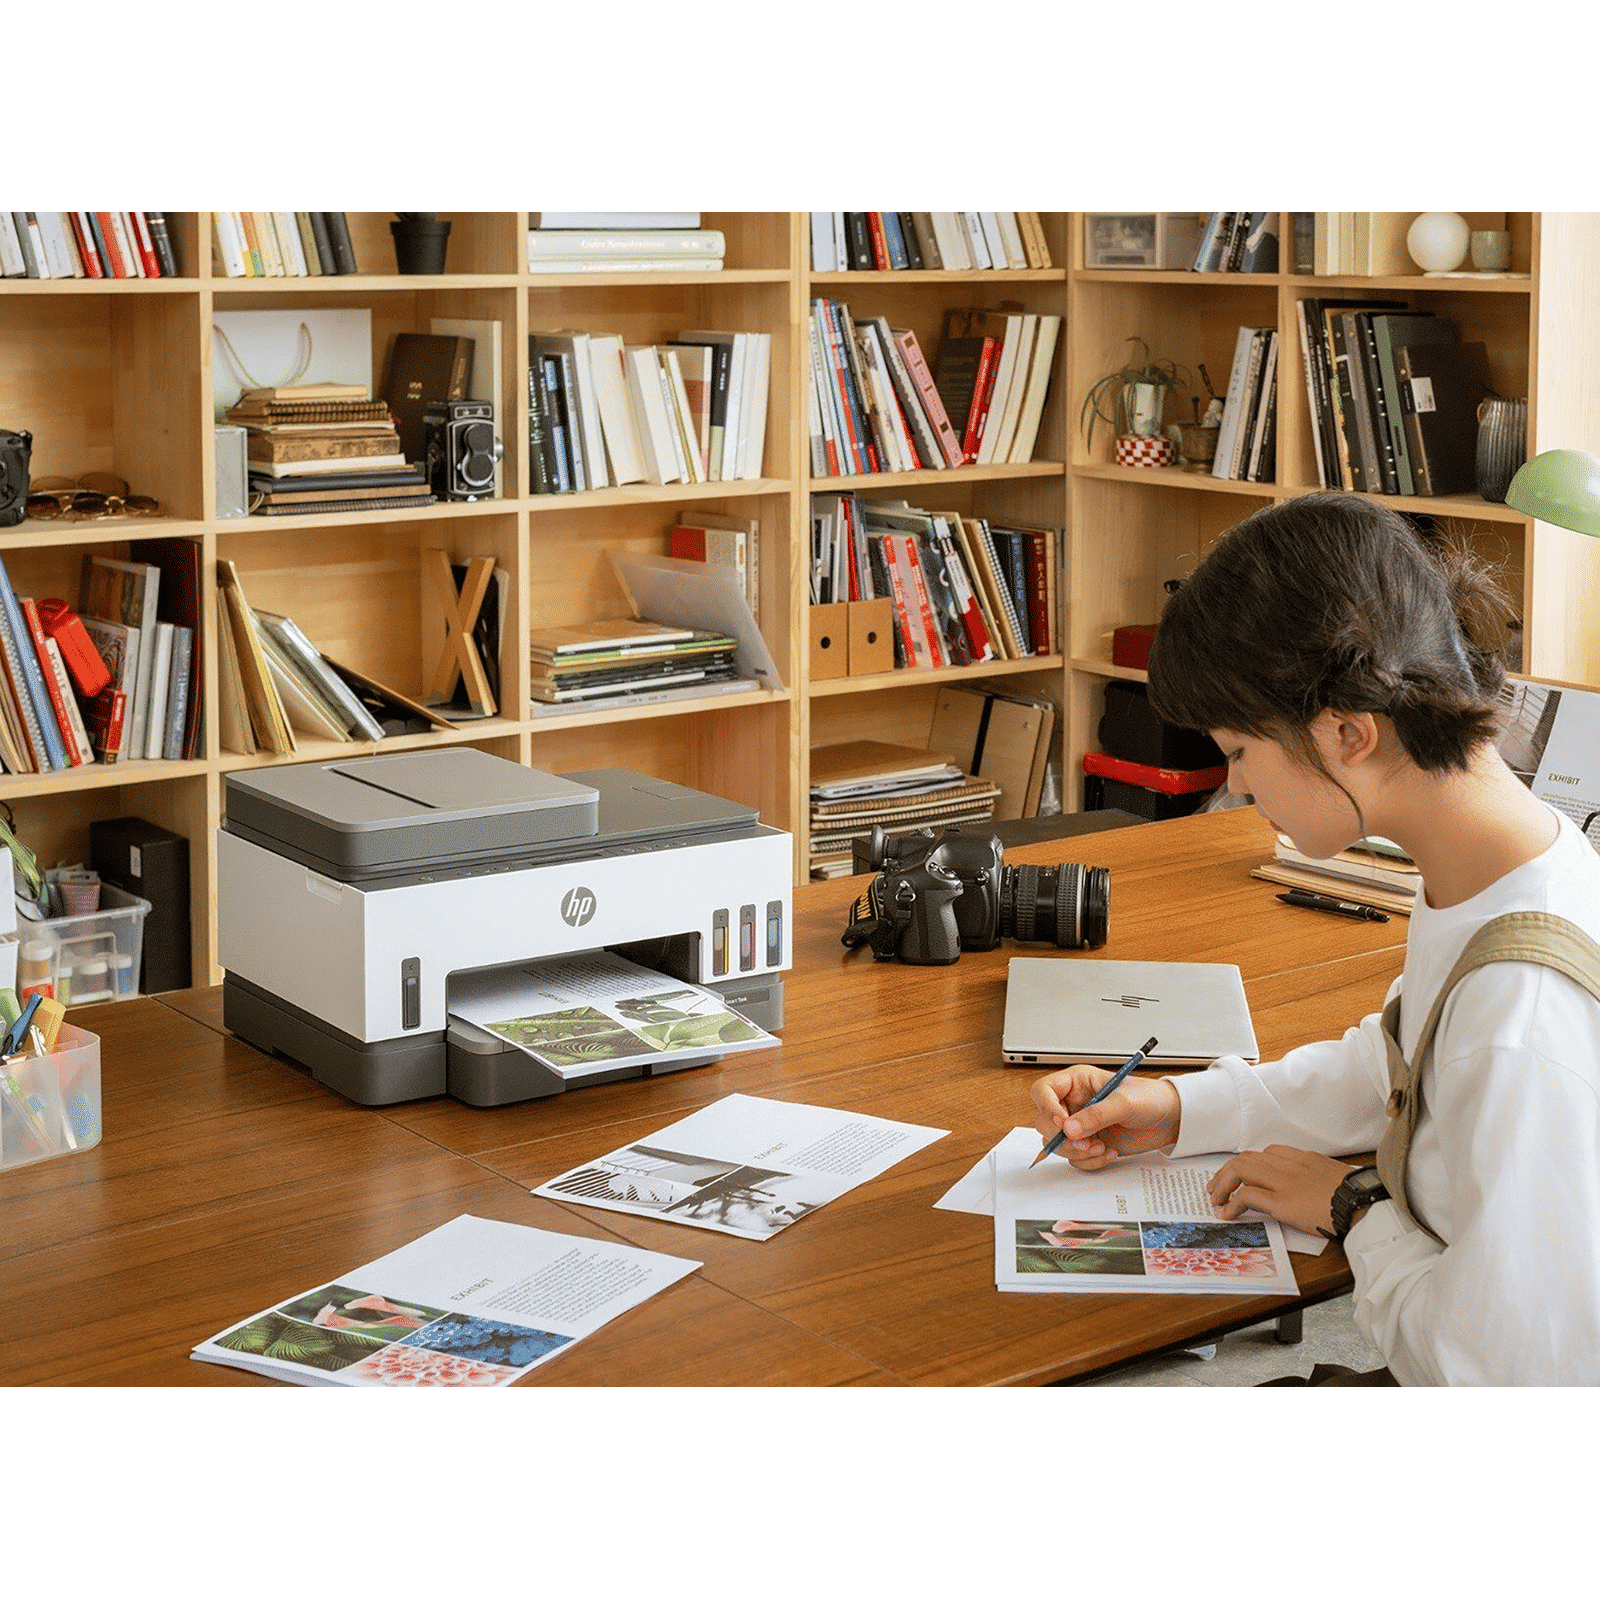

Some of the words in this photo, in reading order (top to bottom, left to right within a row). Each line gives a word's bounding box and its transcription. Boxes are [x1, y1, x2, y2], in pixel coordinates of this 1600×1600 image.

[1548, 773, 1581, 786] EXHIBIT
[563, 887, 595, 927] hp
[856, 892, 872, 920] NIKO
[450, 1277, 493, 1301] EXHIBIT
